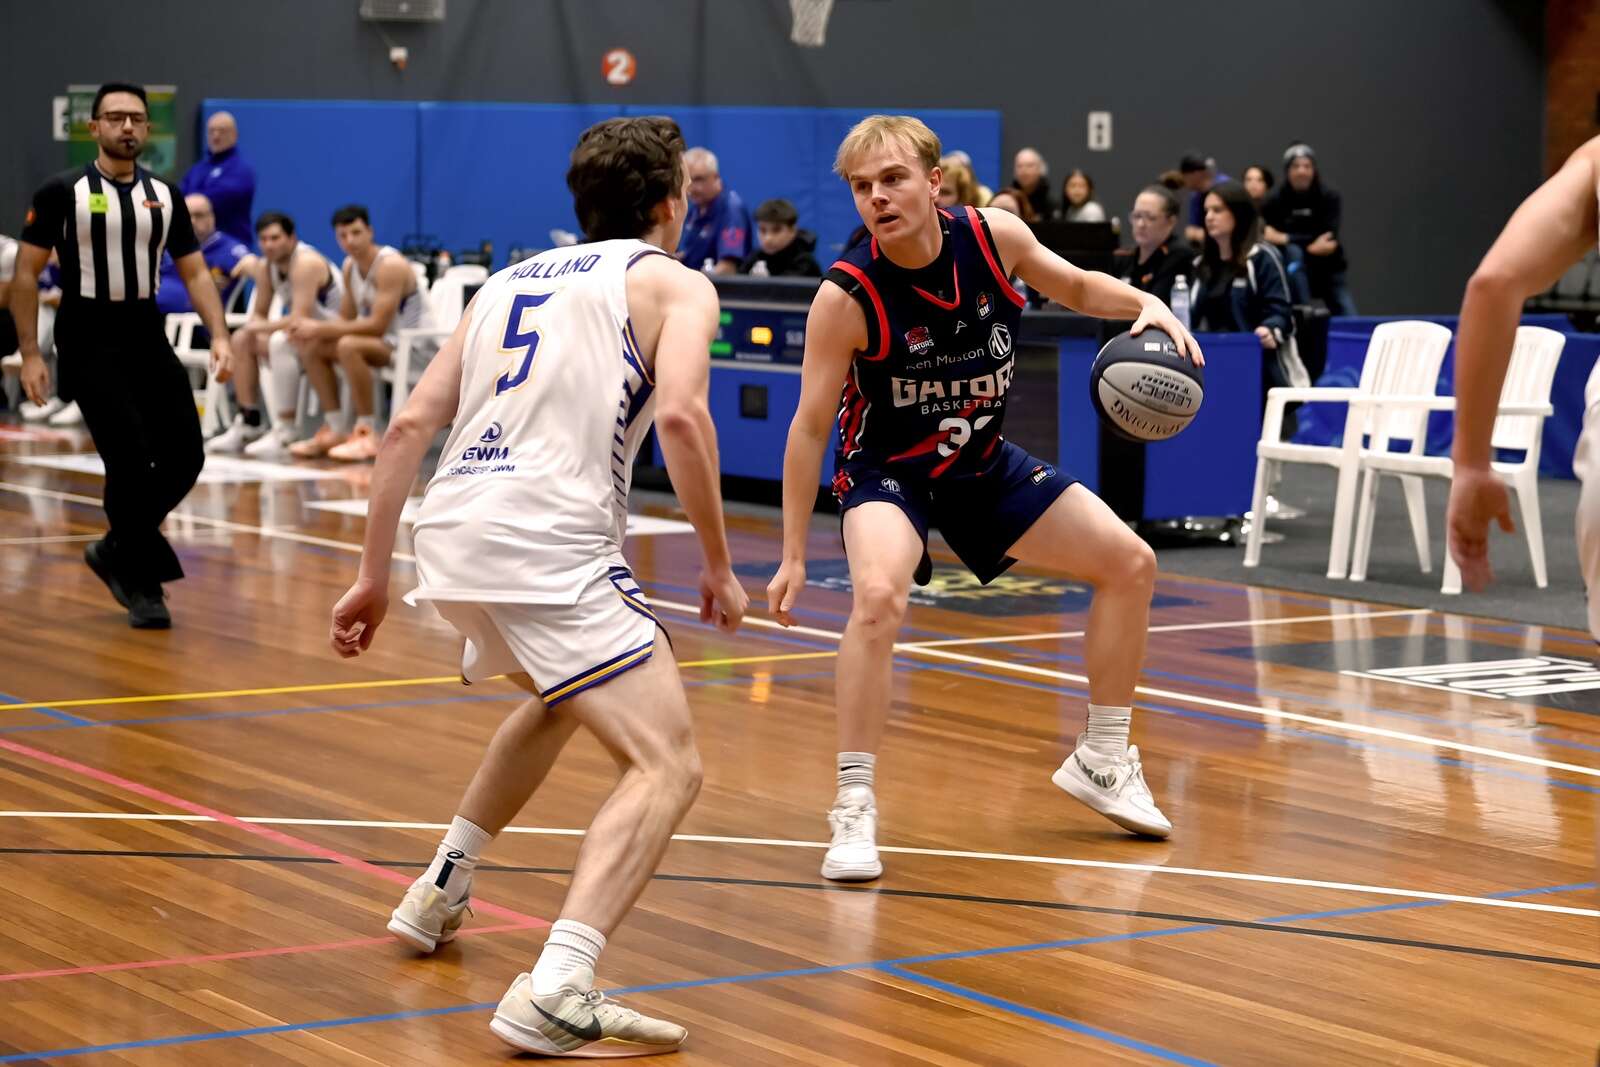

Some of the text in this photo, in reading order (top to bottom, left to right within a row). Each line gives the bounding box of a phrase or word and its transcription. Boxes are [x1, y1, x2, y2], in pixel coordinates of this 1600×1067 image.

[608, 51, 628, 84] 2
[506, 254, 602, 284] HOLLAND
[494, 289, 557, 398] 5
[909, 338, 935, 353] GATORS
[921, 398, 1005, 415] BASKETBA
[1131, 380, 1192, 409] LEGACY
[1111, 399, 1187, 435] PALDING
[937, 415, 995, 458] 3
[462, 446, 509, 461] GWM
